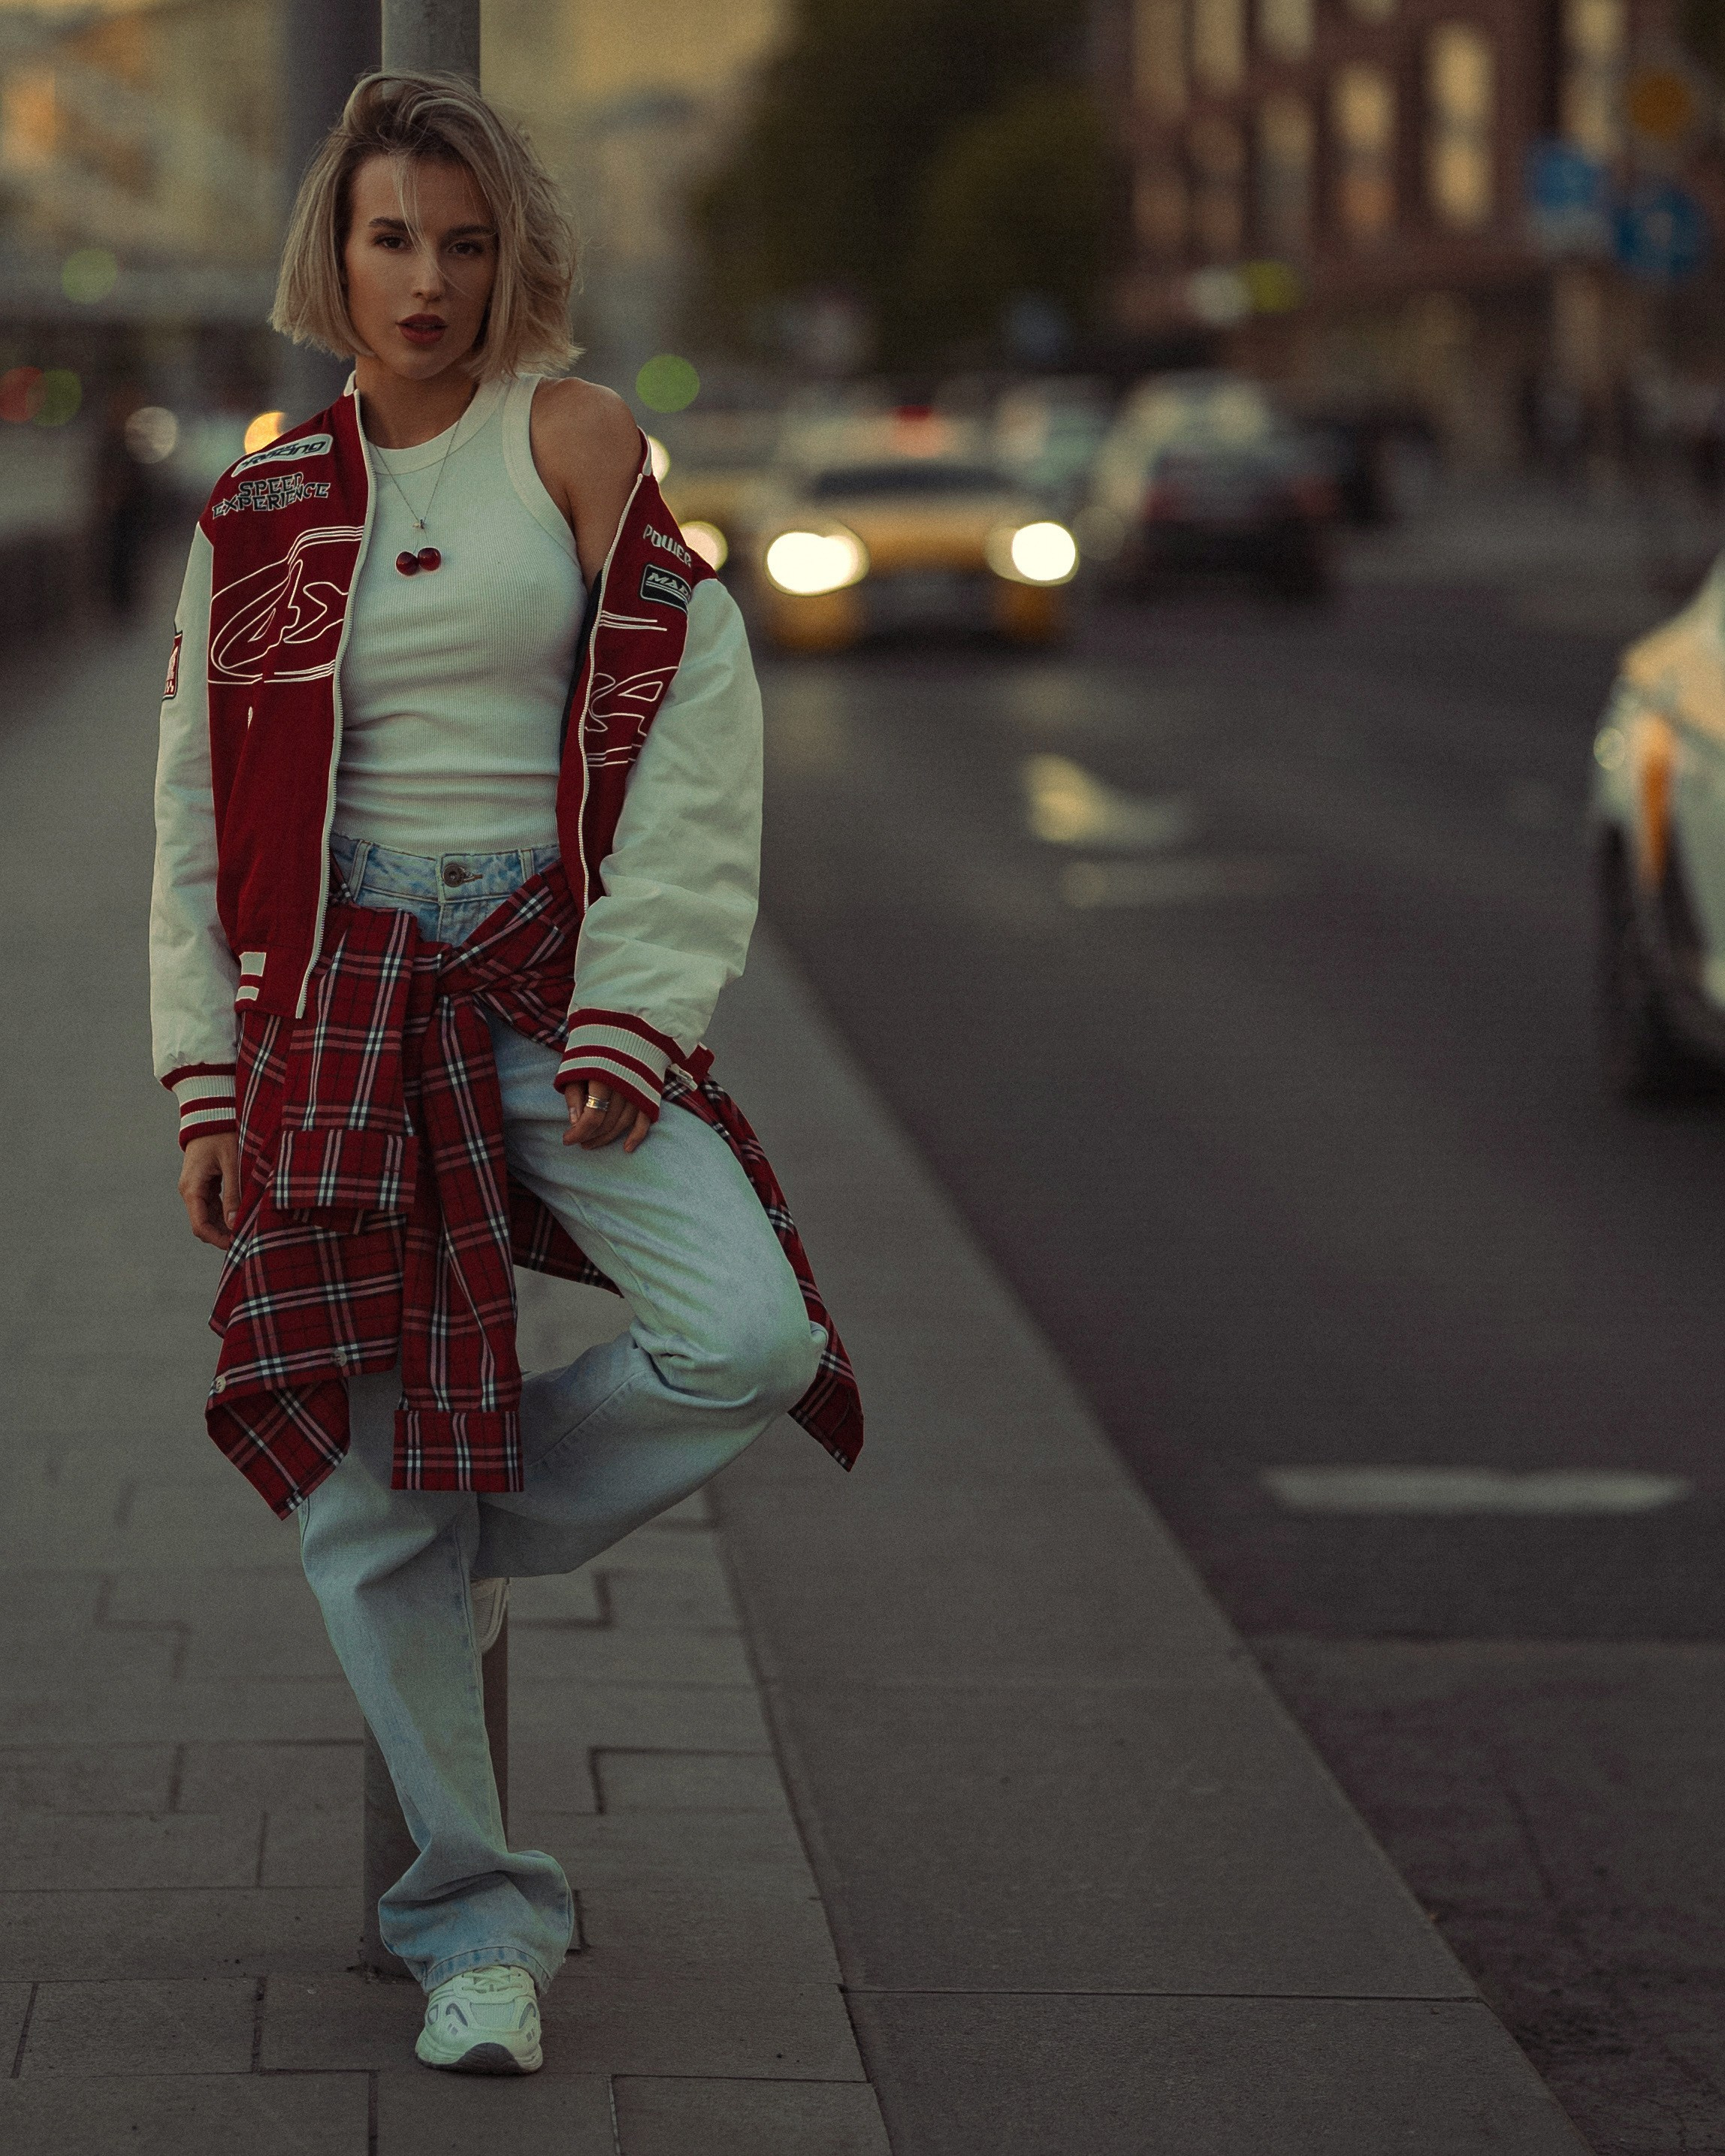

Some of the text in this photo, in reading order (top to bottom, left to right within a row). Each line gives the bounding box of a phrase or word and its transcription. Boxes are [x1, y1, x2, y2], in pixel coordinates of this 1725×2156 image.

[212, 482, 331, 520] EXPERIENCE
[238, 471, 304, 497] SPEED
[642, 524, 692, 568] POWER
[647, 572, 690, 602] MAD
